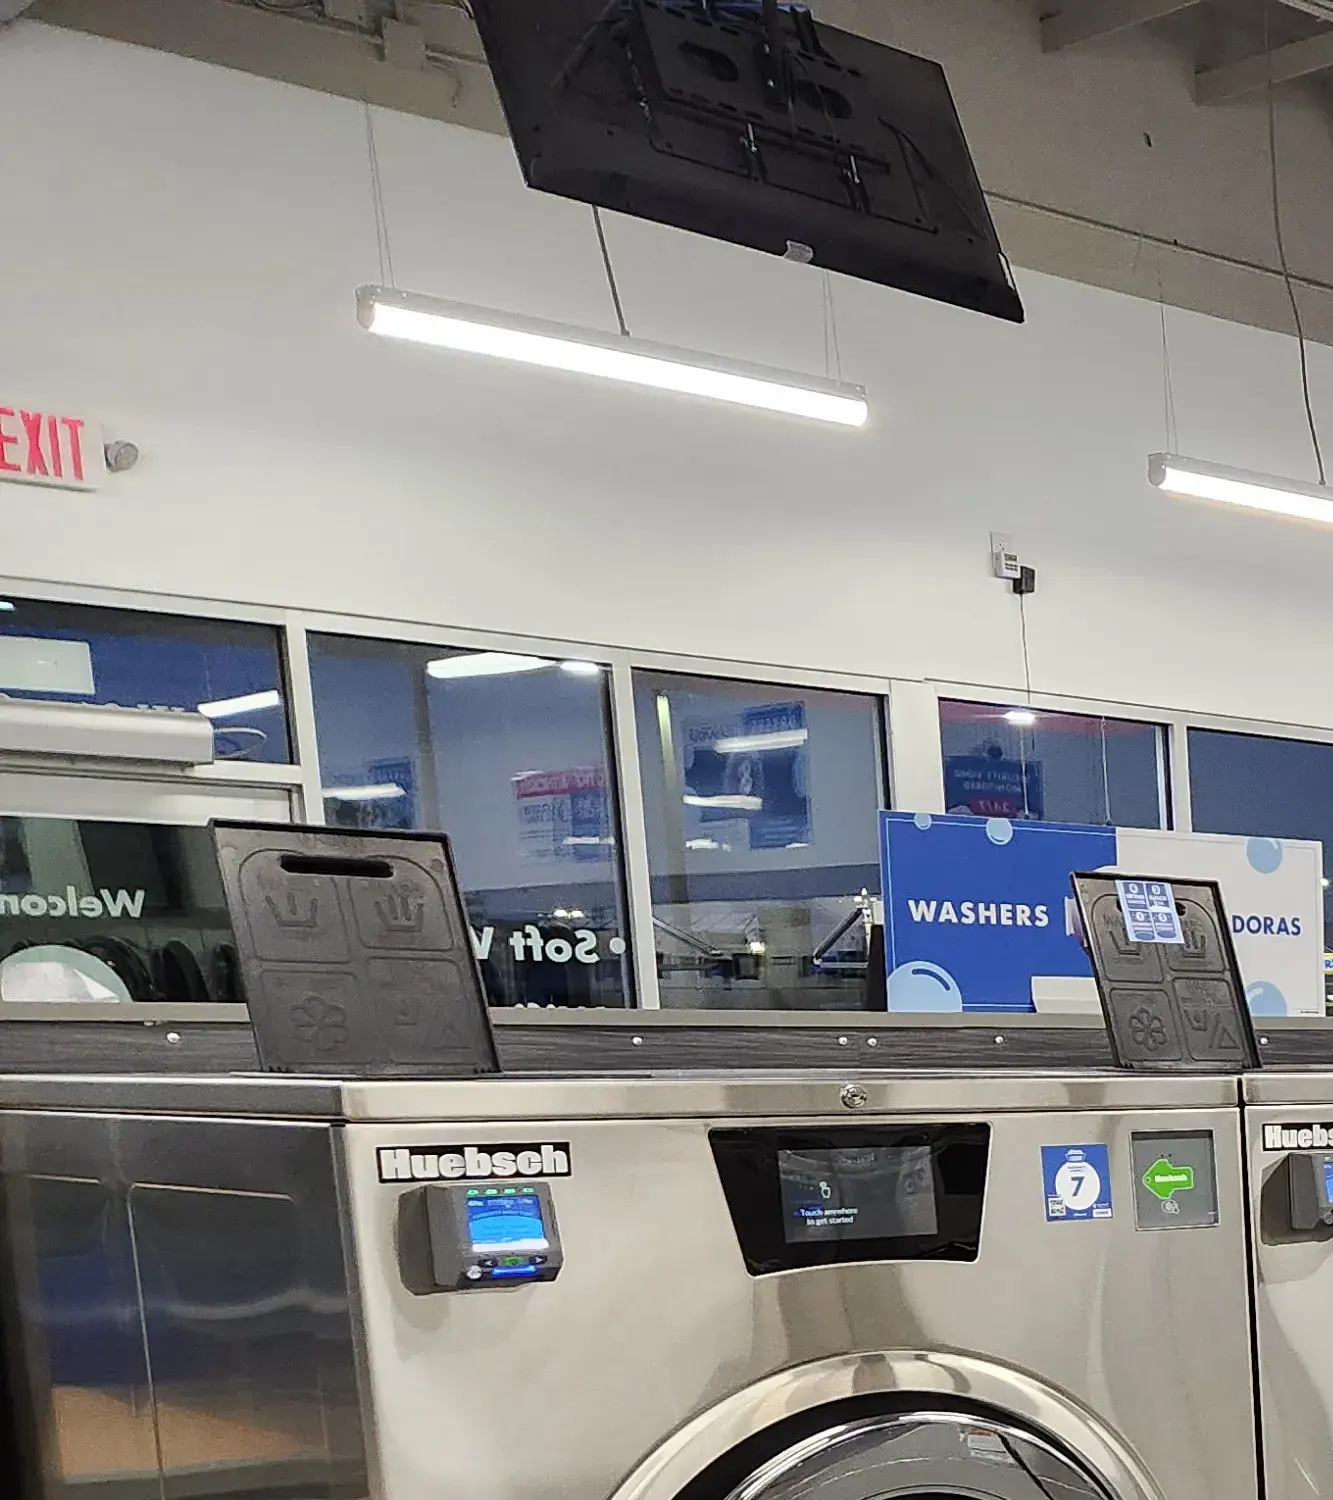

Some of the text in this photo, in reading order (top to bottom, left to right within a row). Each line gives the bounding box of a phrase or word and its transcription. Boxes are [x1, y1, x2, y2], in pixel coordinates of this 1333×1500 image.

[0, 407, 84, 481] EXIT
[907, 898, 1049, 928] WASHERS
[379, 1145, 569, 1179] Huebsch
[1070, 1176, 1085, 1197] 7
[799, 1208, 823, 1217] Touch
